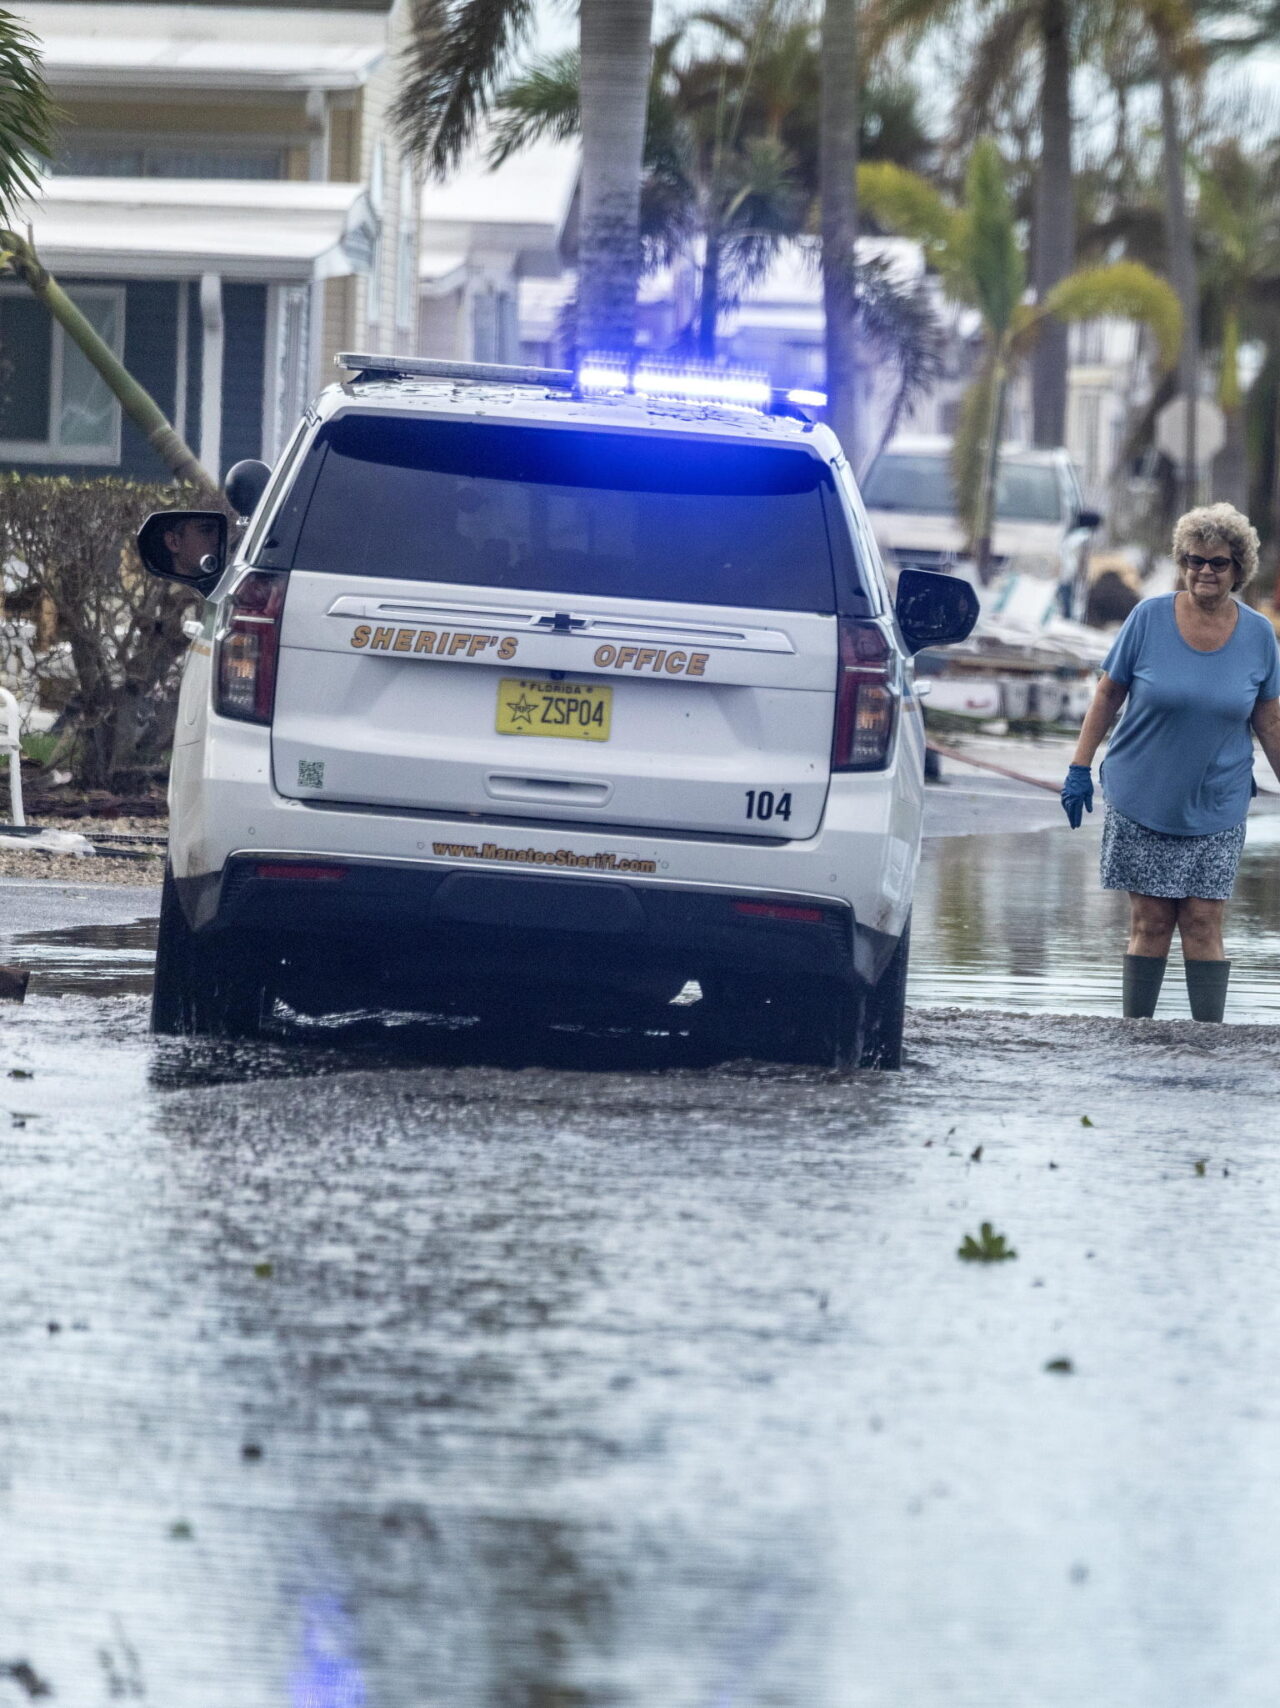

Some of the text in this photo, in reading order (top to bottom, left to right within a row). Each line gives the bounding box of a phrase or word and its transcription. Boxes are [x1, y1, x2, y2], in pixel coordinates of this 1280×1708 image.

[351, 625, 709, 676] SHERIFF'S OFFICE
[529, 683, 581, 694] FLORIDA
[540, 696, 605, 727] ZSP04
[745, 790, 792, 822] 104
[432, 842, 656, 873] www.ManateeSheriff.com
